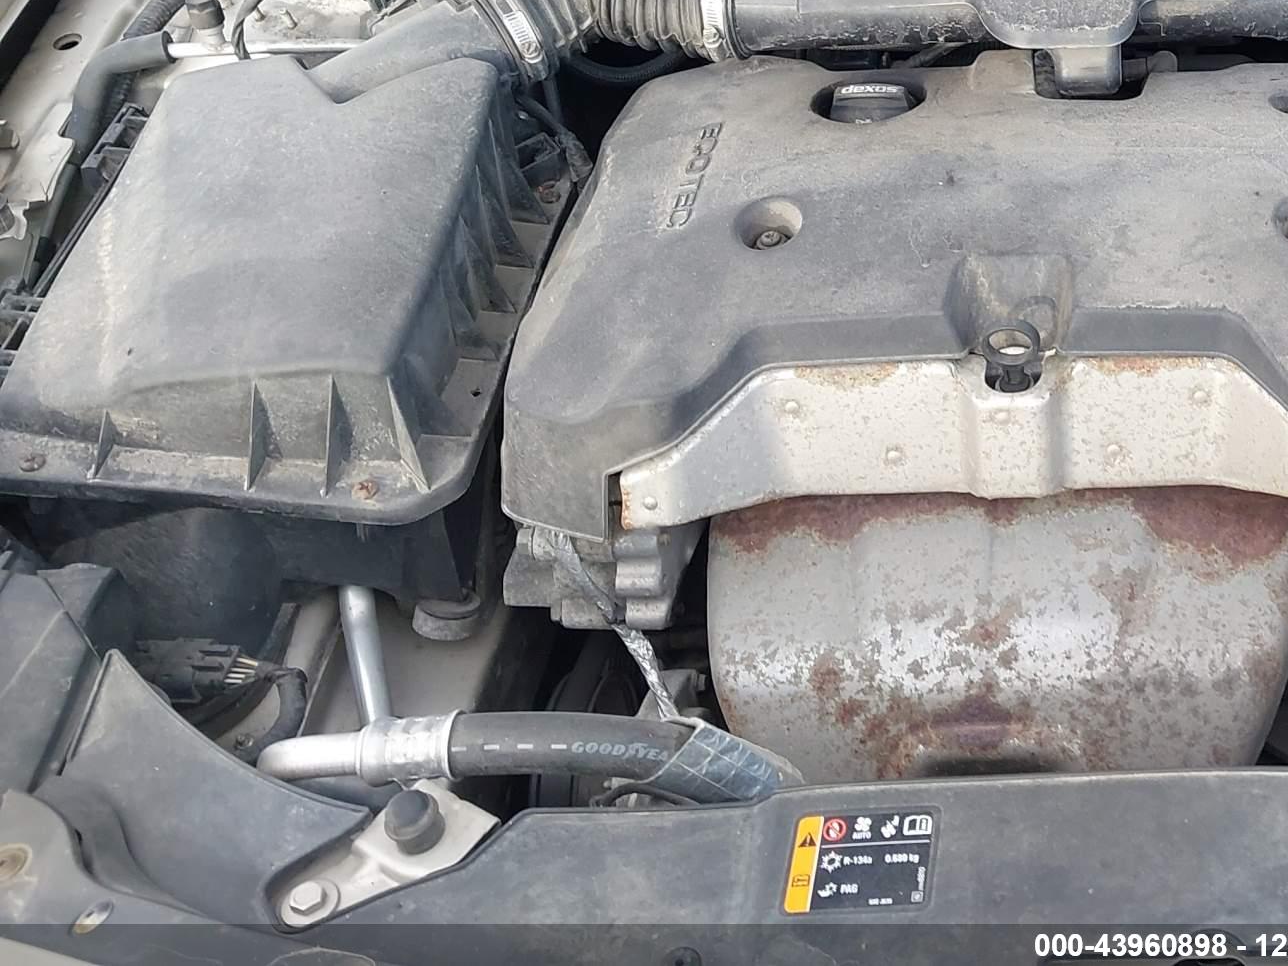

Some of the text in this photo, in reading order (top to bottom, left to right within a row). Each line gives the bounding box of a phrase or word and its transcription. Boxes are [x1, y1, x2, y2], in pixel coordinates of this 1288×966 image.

[841, 84, 897, 94] dexos
[665, 121, 726, 228] ECOTEC
[570, 740, 669, 762] GOODYEA
[852, 831, 872, 840] AUTO
[843, 855, 873, 866] R-134a
